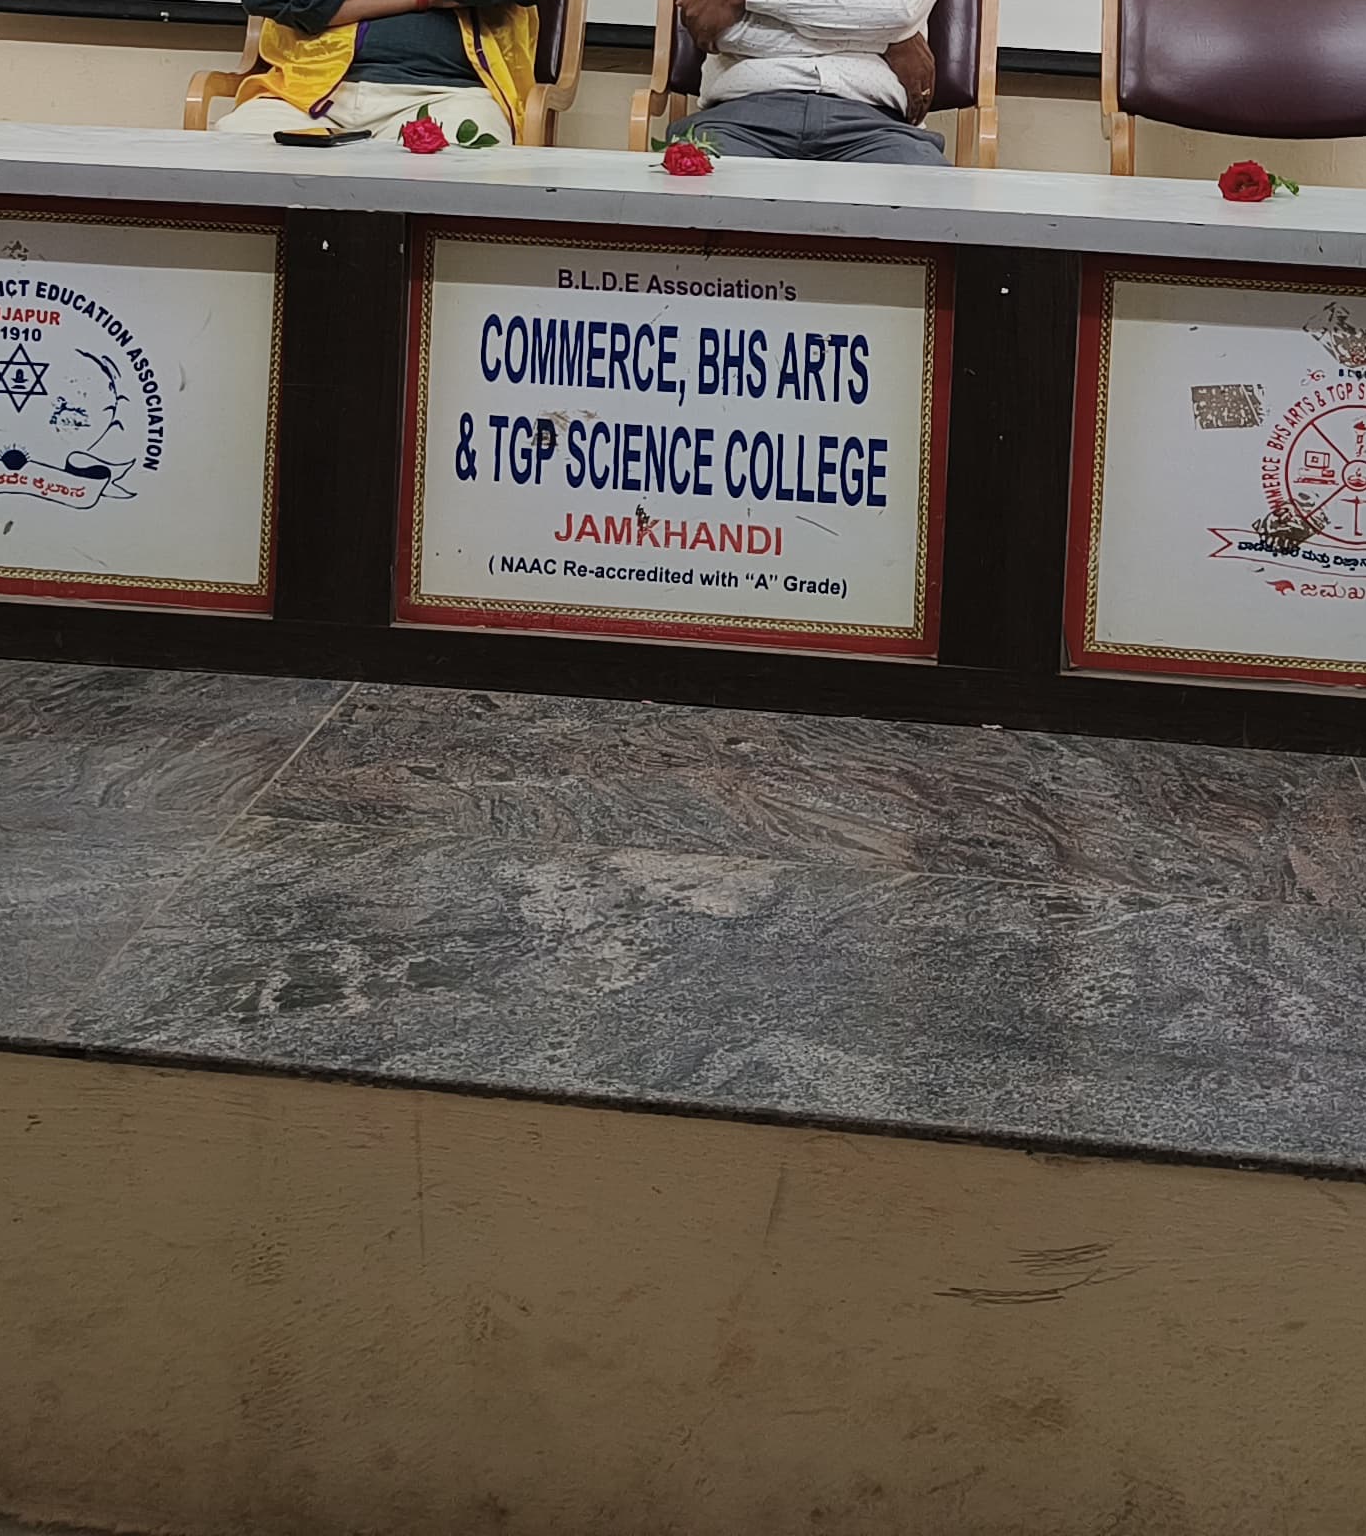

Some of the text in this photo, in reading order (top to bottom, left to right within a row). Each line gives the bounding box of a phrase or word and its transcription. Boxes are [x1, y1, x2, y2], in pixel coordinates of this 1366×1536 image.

[557, 268, 797, 302] B.L.D.E Association's
[0, 325, 43, 343] 1910
[480, 313, 870, 407] COMMERCE, BHS ARTS
[35, 281, 134, 348] EDUCATION
[126, 347, 165, 472] ASSOCIATION
[1267, 424, 1291, 451] BHS
[1283, 396, 1316, 428] ARTS
[1315, 390, 1327, 407] &
[1326, 382, 1353, 402] TGP
[455, 411, 889, 508] & TGP SCIENCE COLLEGE
[554, 512, 783, 556] JAMKHANDI
[500, 555, 557, 577] NAAC
[563, 560, 694, 587] Re-accredited
[699, 567, 740, 589] with
[783, 574, 848, 599] Grade)
